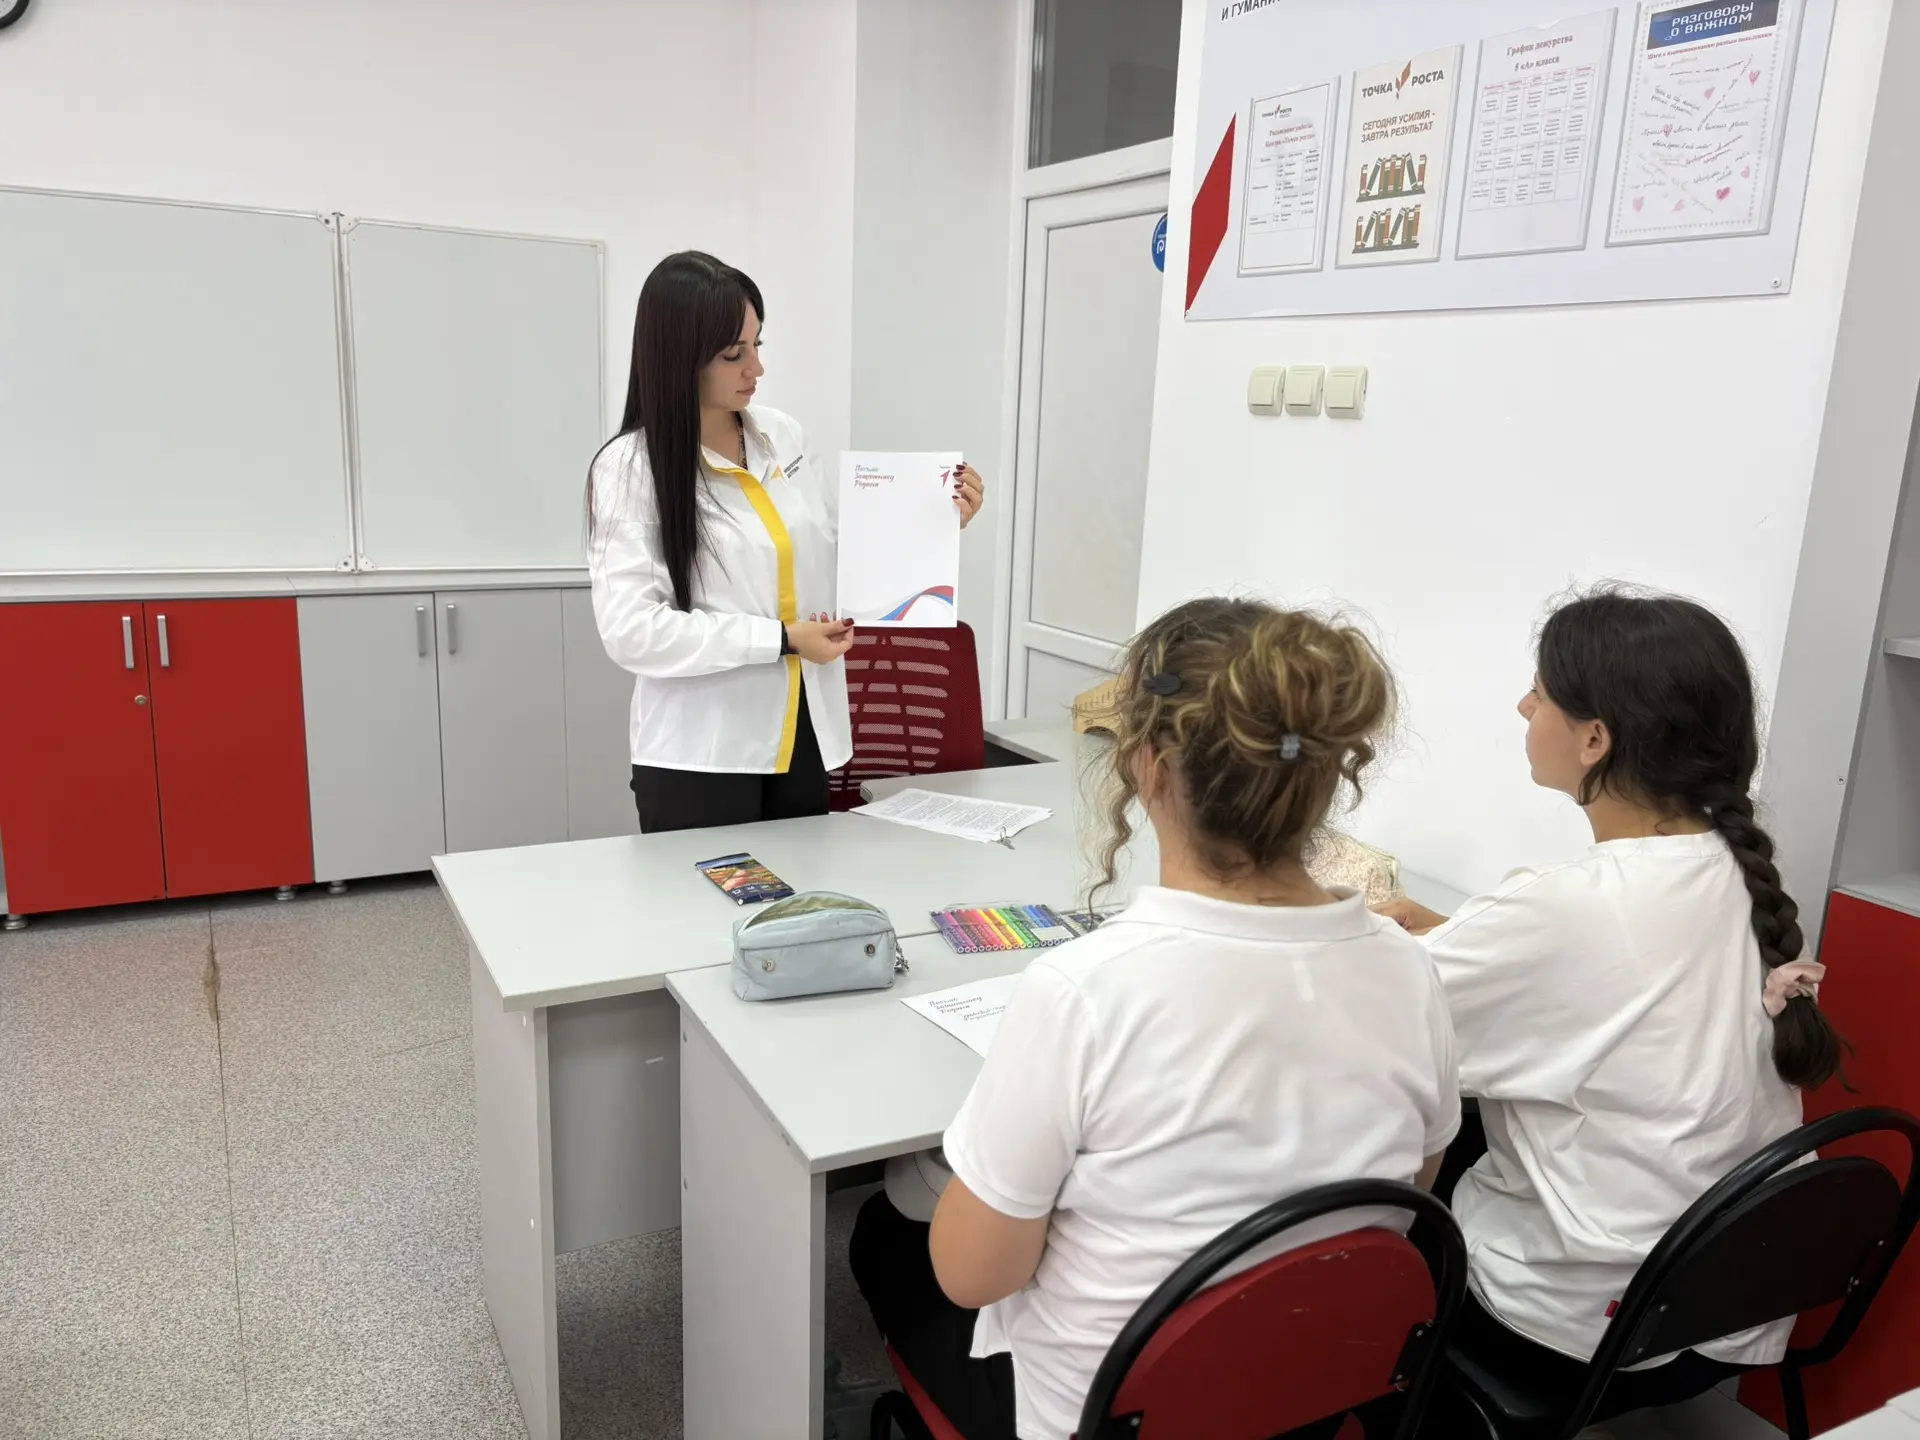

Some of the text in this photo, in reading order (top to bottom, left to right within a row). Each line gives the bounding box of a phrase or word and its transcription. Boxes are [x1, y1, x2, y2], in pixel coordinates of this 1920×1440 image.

[1221, 7, 1229, 20] И
[1671, 2, 1754, 27] РАЗГОВОРЫ
[1671, 13, 1753, 37] О ВАЖНОМ
[1506, 35, 1574, 57] График дежурства
[1535, 56, 1560, 68] класса
[1362, 69, 1444, 98] ТОЧКА РОСТА
[1362, 116, 1398, 132] СЕГОДНЯ
[1399, 109, 1431, 125] УСИЛИЯ
[1361, 121, 1434, 143] ЗАВТРА РЕЗУЛЬТАТ
